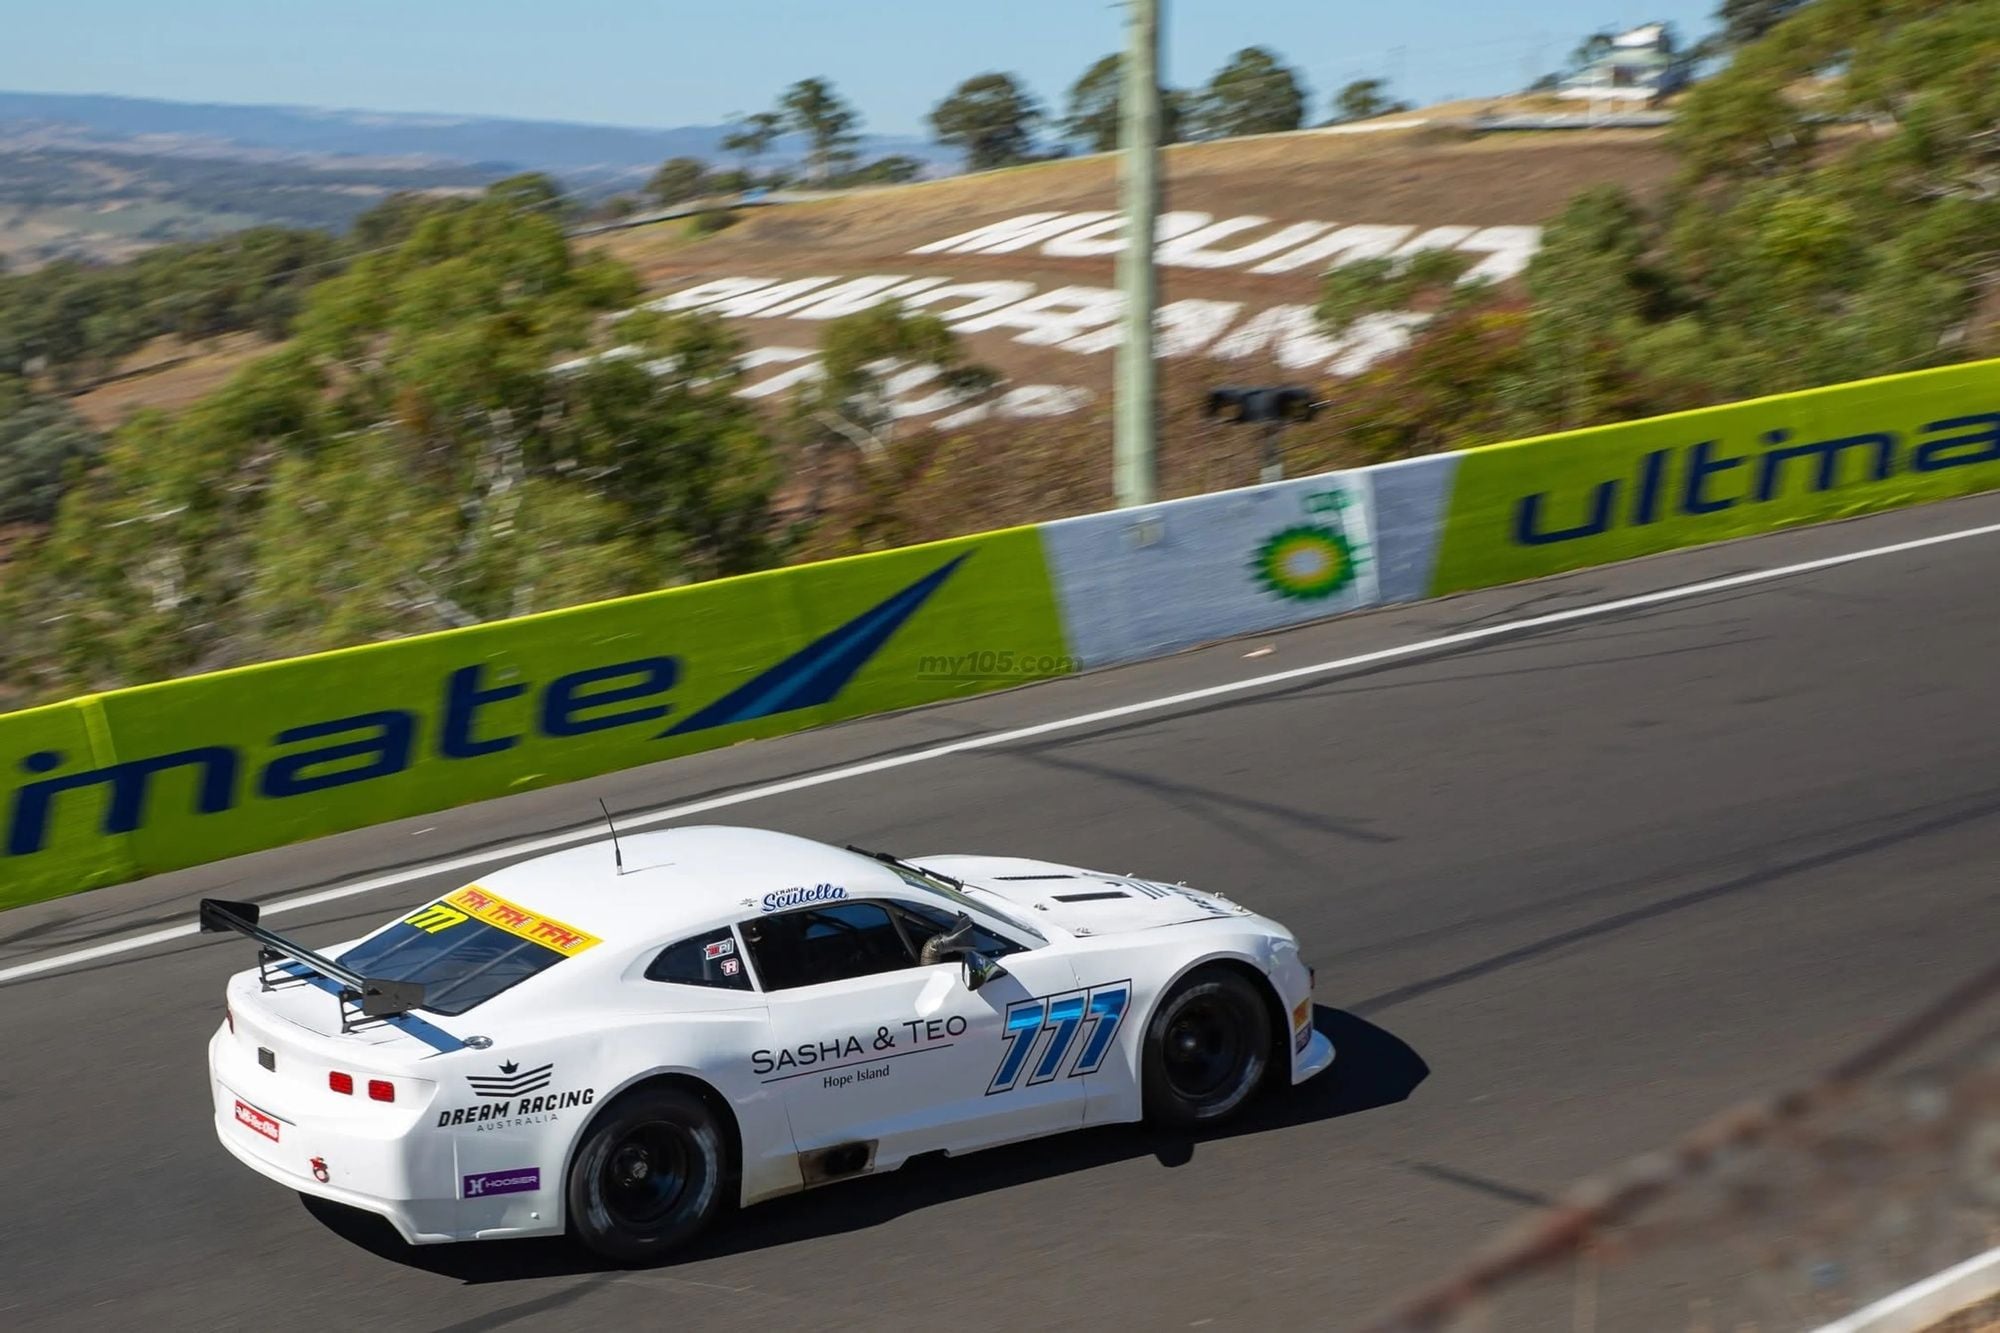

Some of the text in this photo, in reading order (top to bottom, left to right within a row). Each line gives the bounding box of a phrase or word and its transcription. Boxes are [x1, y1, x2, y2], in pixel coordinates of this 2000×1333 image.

[762, 883, 848, 912] Scutella
[751, 1015, 967, 1075] SASHA & TEO
[985, 979, 1132, 1096] 777
[823, 1065, 890, 1089] Hope Island
[437, 1088, 594, 1128] DREAM RACING
[476, 1113, 559, 1132] AUSTRALIA
[485, 1175, 538, 1188] HOOSIER
